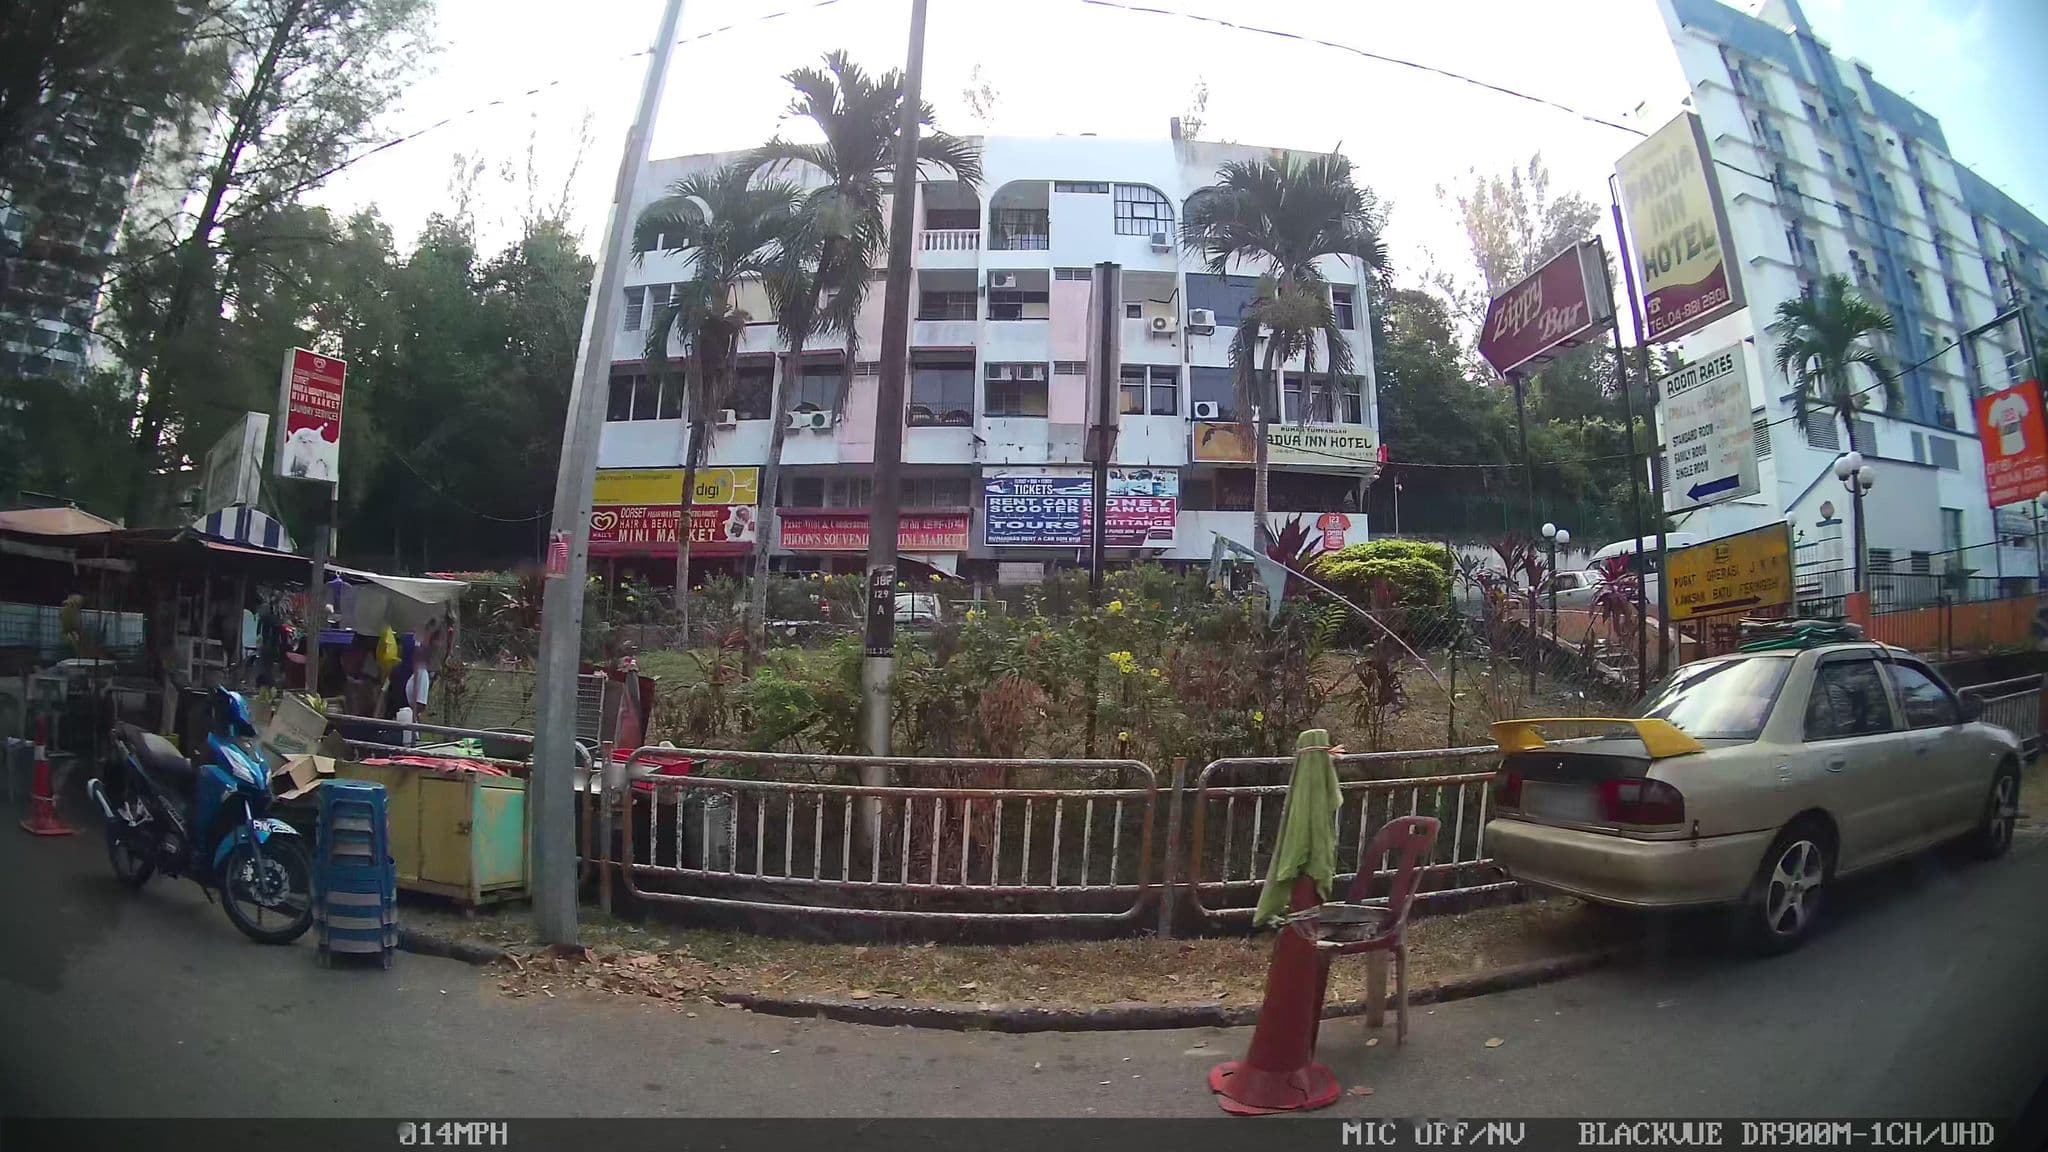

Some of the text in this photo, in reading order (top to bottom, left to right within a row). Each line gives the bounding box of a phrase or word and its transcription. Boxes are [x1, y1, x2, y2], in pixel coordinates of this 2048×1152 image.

[1643, 219, 1715, 282] HOTEL
[1493, 275, 1542, 342] Zippy
[1539, 300, 1583, 342] Bar
[1667, 354, 1733, 395] ROOM RATES
[1267, 434, 1373, 449] ADUA INN HOTEL
[696, 482, 719, 499] digi
[1014, 484, 1053, 495] TICKETS
[990, 498, 1079, 506] RENT CAR
[621, 507, 647, 518] DORSET
[619, 519, 638, 529] HAIR
[642, 519, 647, 529] &
[651, 519, 680, 529] BEAUT
[990, 521, 1080, 529] TOURS
[619, 529, 716, 542] MINI MAKET
[874, 590, 889, 599] 129
[876, 604, 885, 615] A
